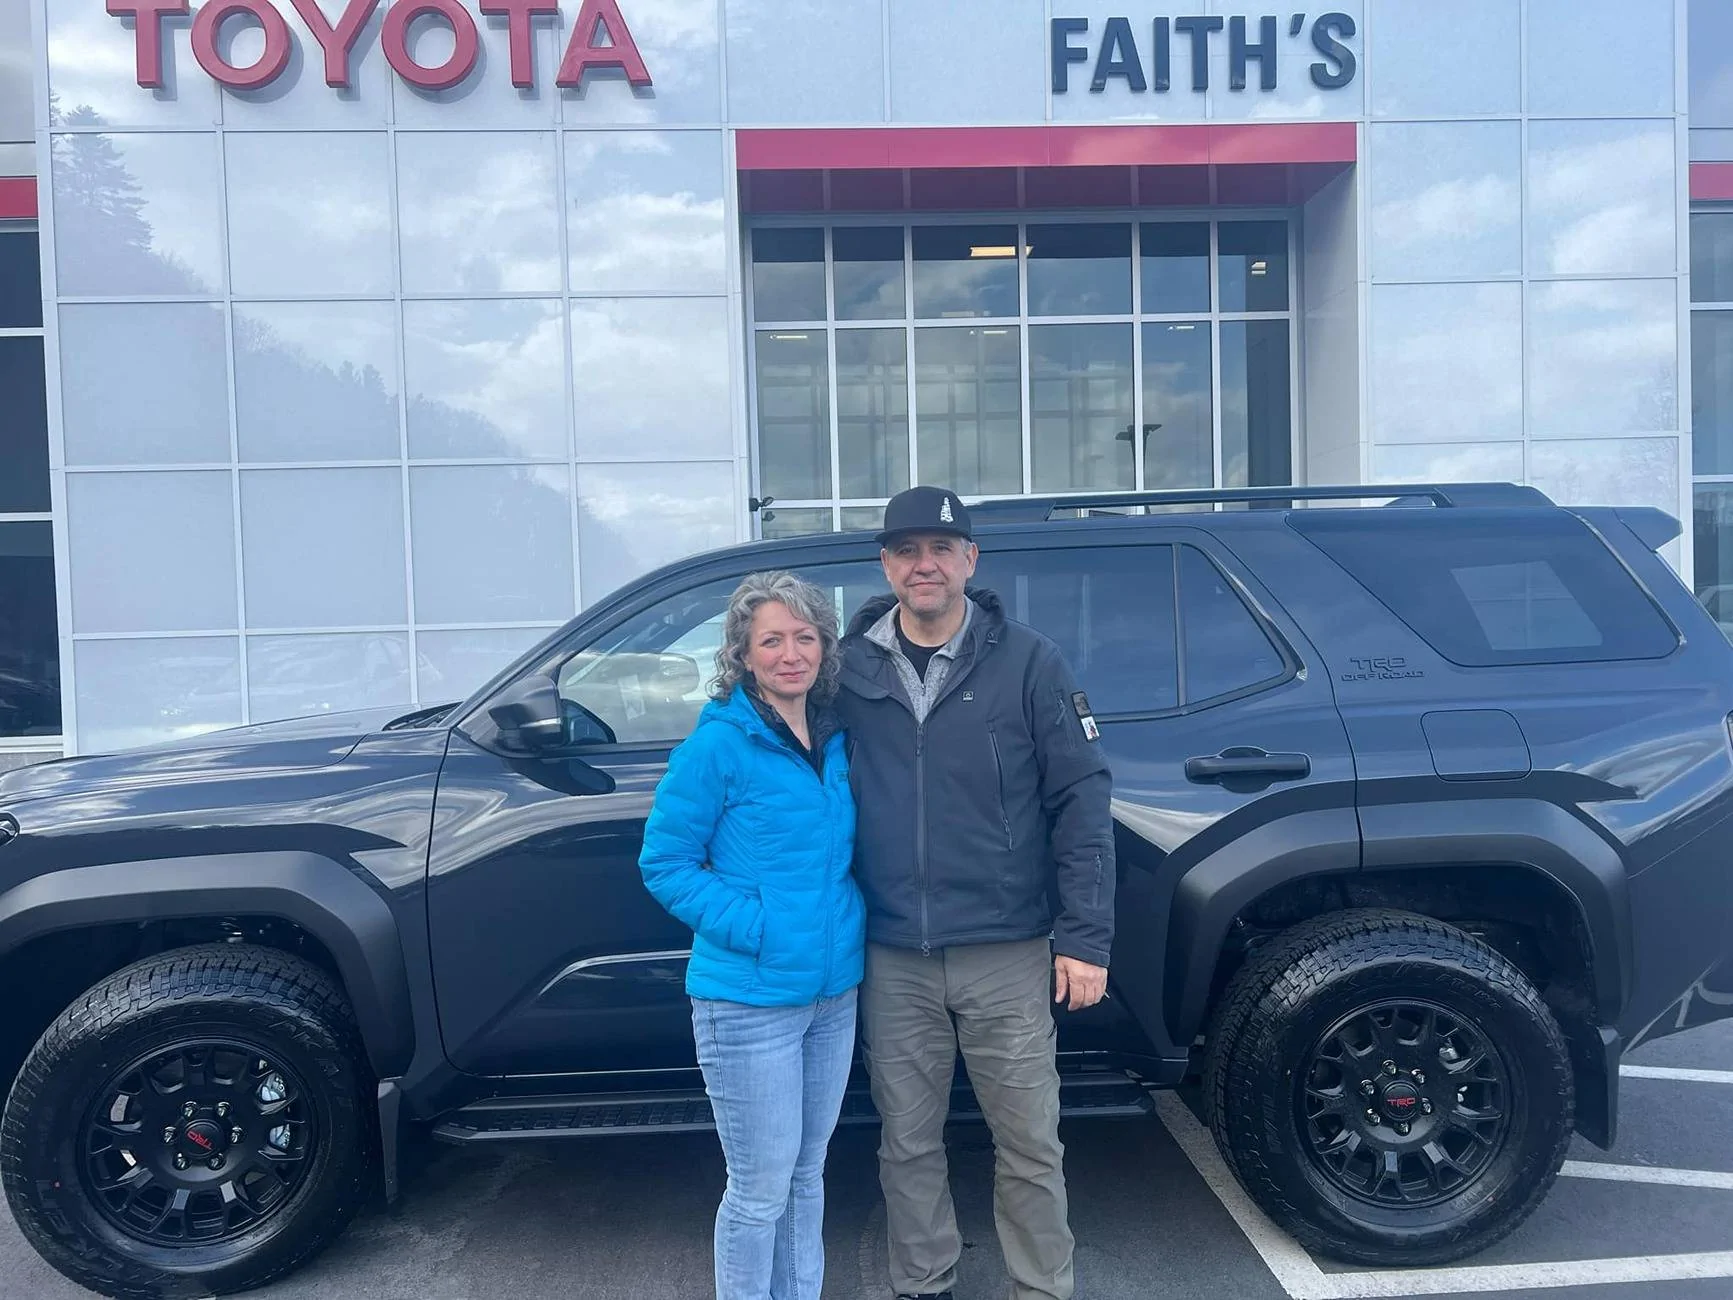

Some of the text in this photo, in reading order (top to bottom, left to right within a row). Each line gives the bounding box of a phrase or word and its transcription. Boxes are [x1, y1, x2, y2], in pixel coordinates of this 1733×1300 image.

[106, 0, 653, 89] TOYOTA
[1051, 12, 1356, 93] FAITH'S
[1350, 657, 1406, 673] TRD
[1387, 1097, 1416, 1107] TRD
[187, 1130, 212, 1150] TRD
